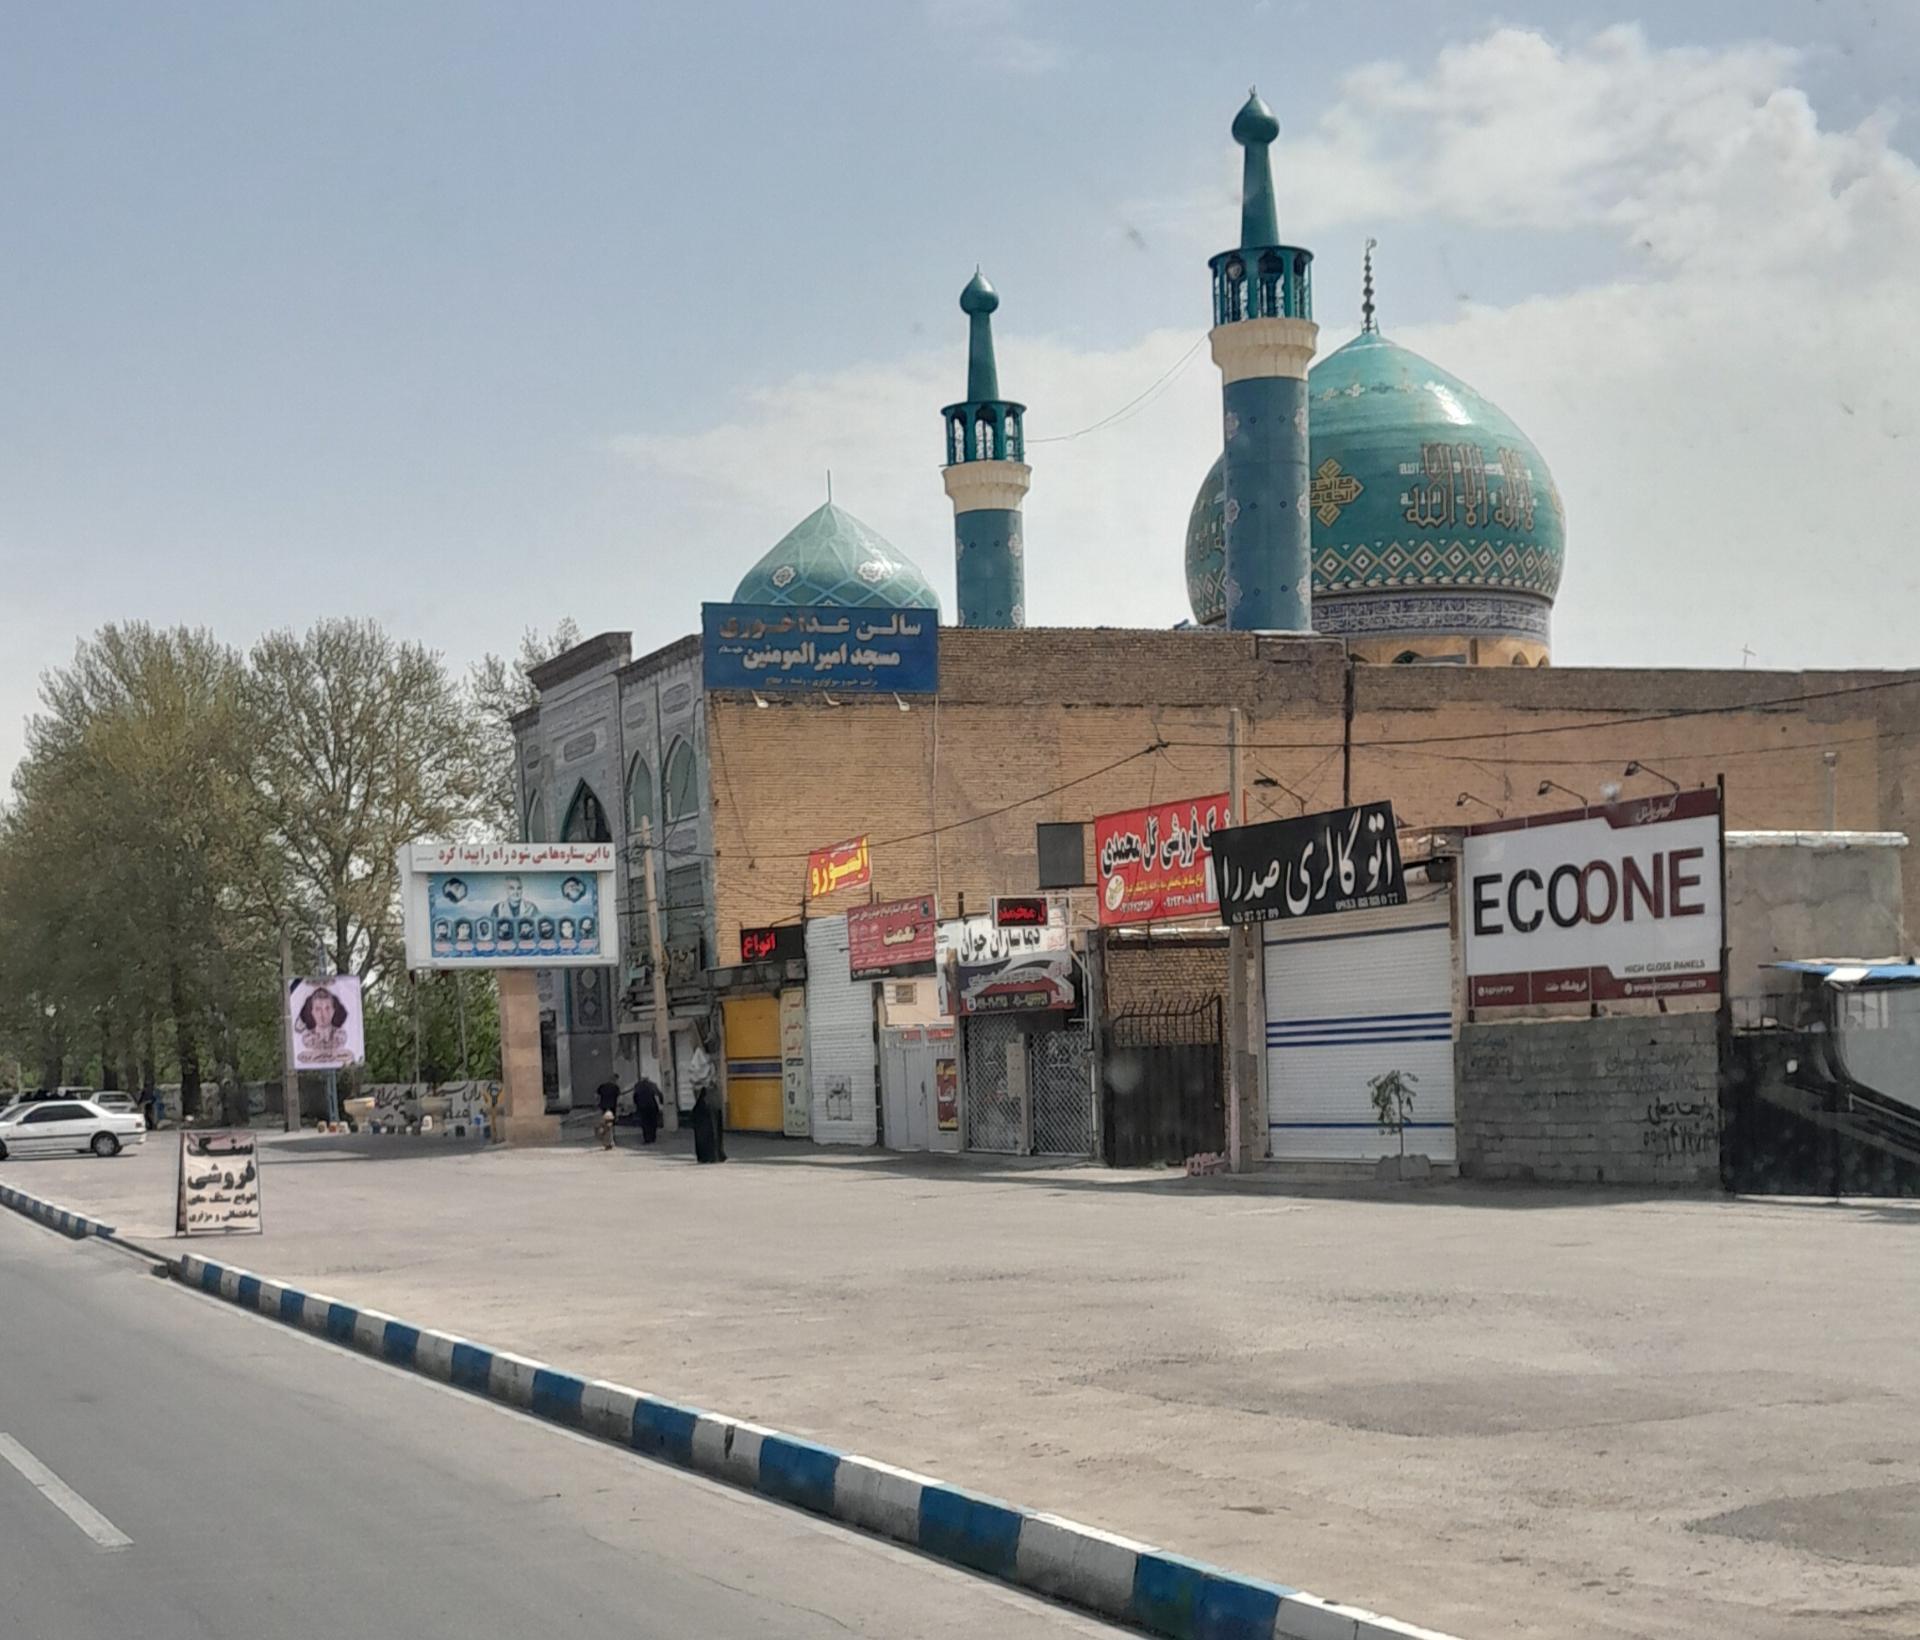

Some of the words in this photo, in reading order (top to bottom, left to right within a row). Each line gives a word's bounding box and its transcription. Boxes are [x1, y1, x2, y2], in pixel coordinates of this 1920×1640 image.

[855, 613, 922, 641] سالن
[814, 641, 847, 672] امیر
[849, 646, 901, 672] مسجد
[1142, 815, 1159, 872] گل
[1159, 805, 1199, 870] فروشی
[438, 846, 456, 865] کرد
[459, 847, 480, 865] پیدا
[492, 847, 509, 865] راه
[511, 846, 530, 864] شود
[585, 847, 601, 863] این
[602, 847, 610, 860] با
[1101, 831, 1142, 878] محمدی
[1285, 807, 1361, 915] گالری
[1366, 812, 1394, 892] اتو
[1223, 855, 1280, 902] صدرا
[1473, 847, 1706, 937] ECOONE
[743, 932, 776, 960] انواع
[1624, 963, 1645, 974] HIGH
[1646, 962, 1672, 972] GLOSS
[1673, 959, 1706, 971] PANELS
[187, 1160, 257, 1190] فروشی
